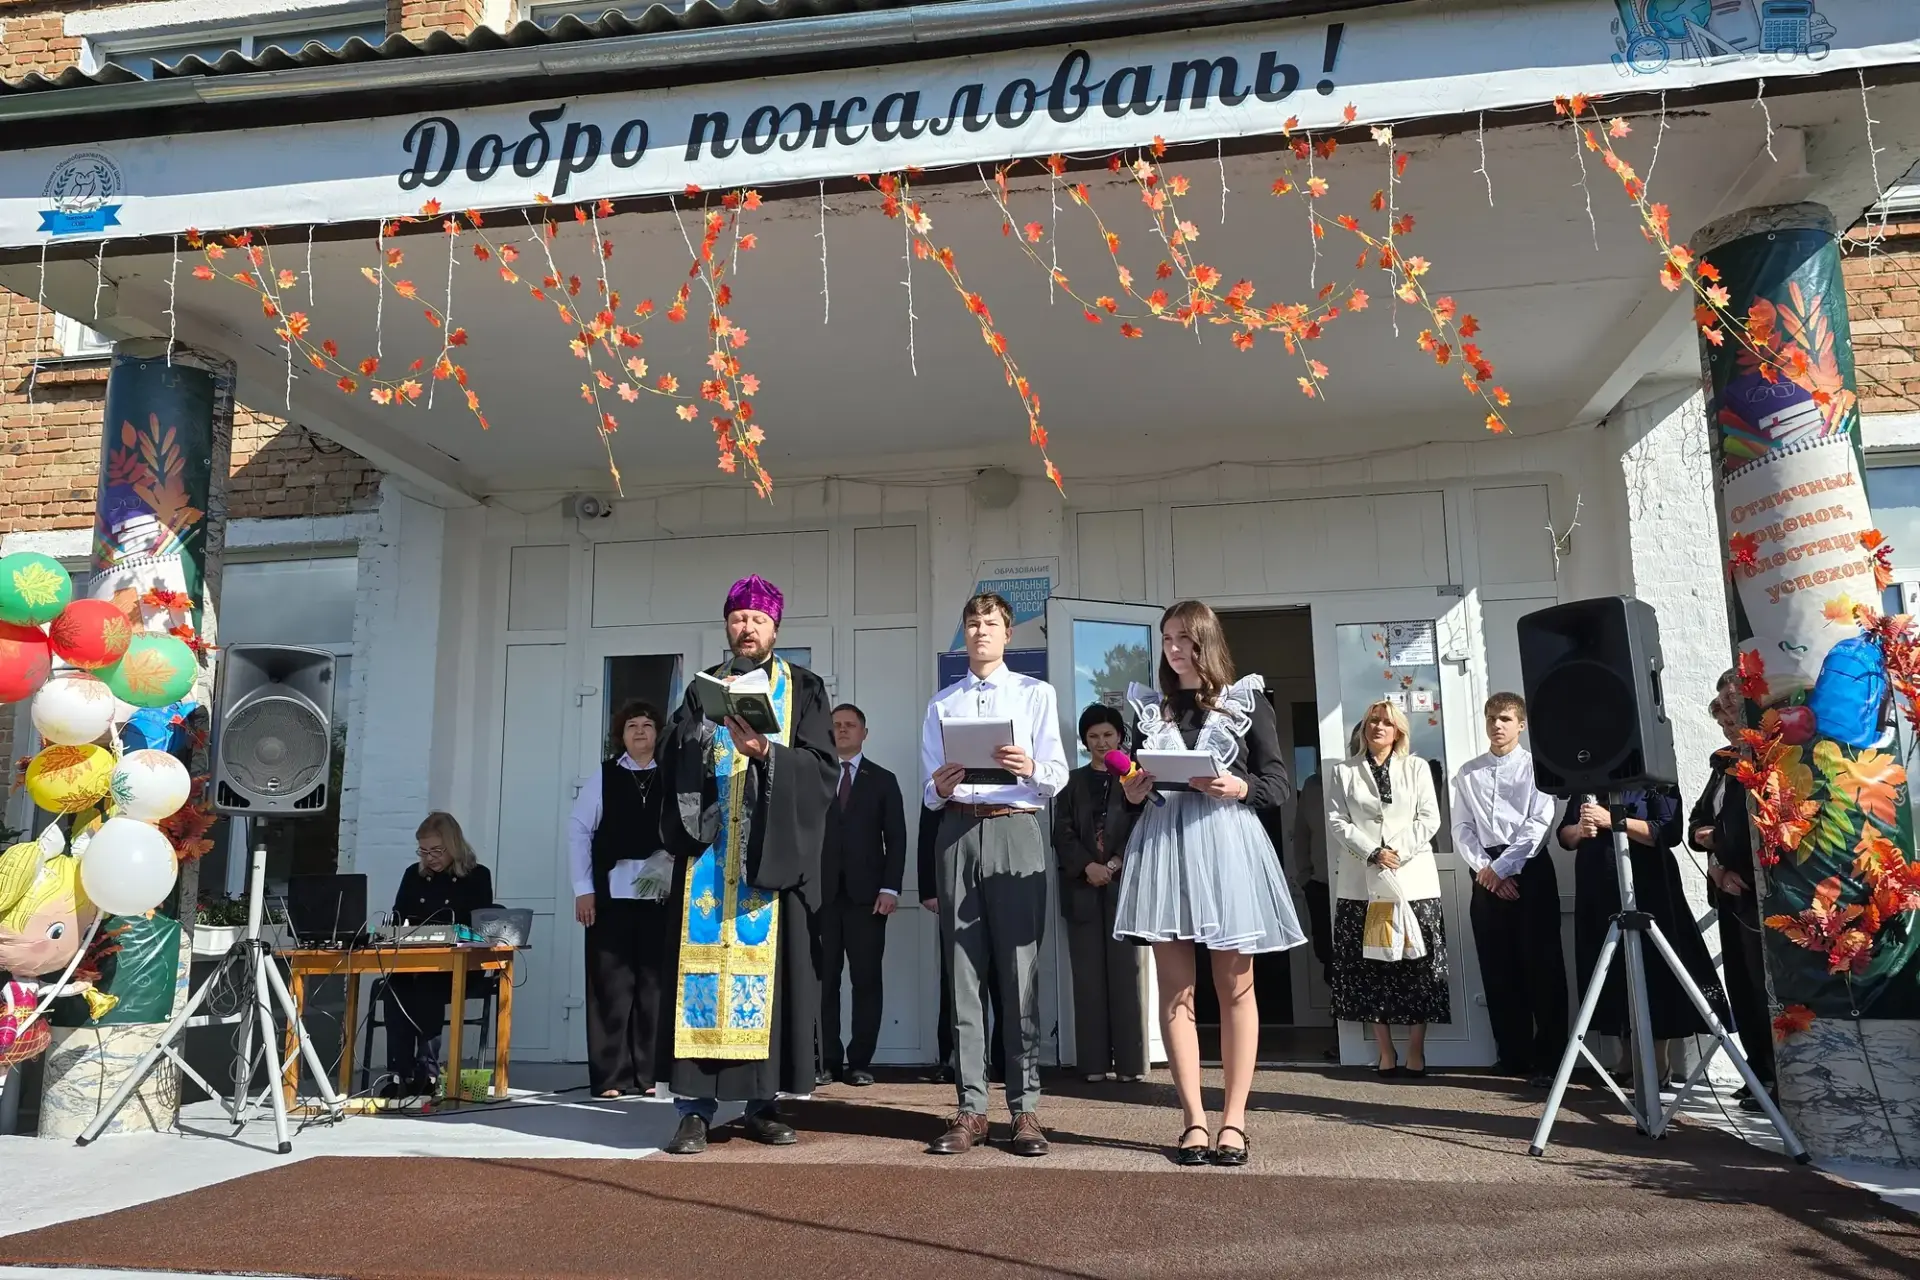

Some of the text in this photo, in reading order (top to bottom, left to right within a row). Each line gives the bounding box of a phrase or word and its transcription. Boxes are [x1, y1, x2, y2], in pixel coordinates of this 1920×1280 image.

[398, 22, 1345, 198] Добро пожаловать!
[1730, 471, 1856, 525] Отличных
[1752, 503, 1853, 544] оценок,
[994, 565, 1050, 575] ОБРАЗОВАНИЕ
[981, 579, 1049, 593] НАЦИОНАЛЬНЫЕ
[1010, 590, 1049, 602] ПРОЕКТЫ
